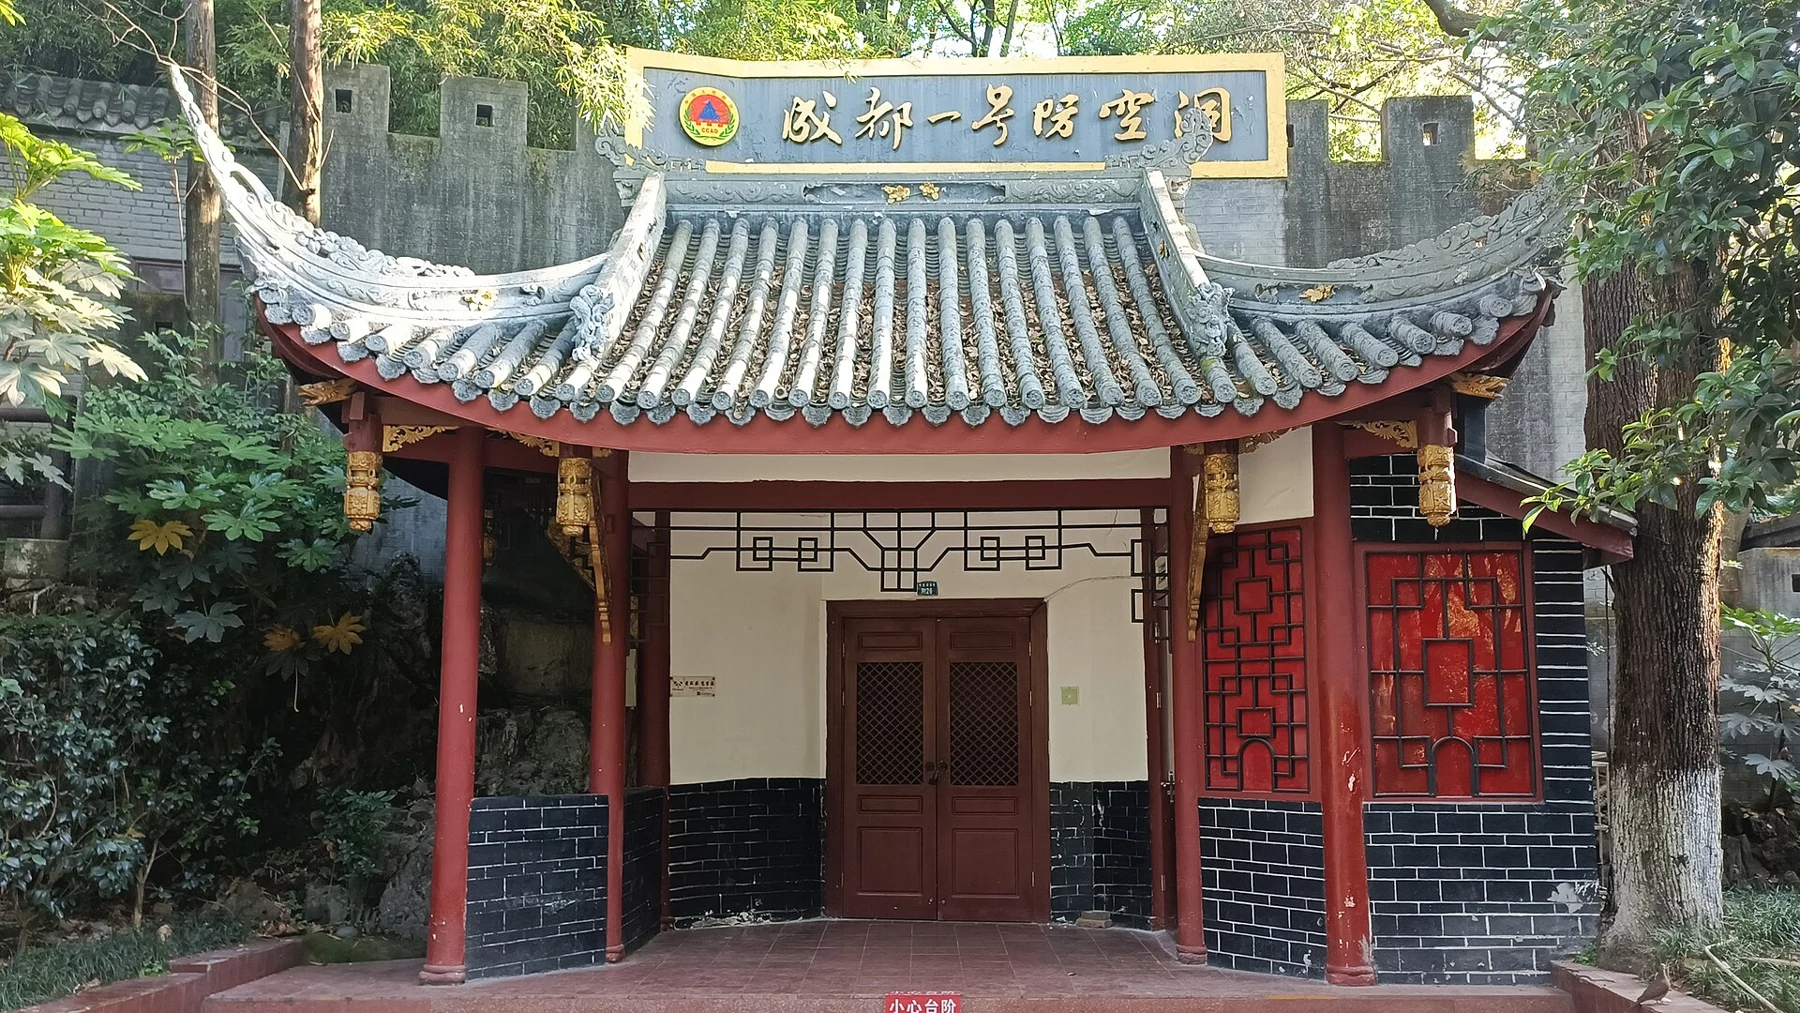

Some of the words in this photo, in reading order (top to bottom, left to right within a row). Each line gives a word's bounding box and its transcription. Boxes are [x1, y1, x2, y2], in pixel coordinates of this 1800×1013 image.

[782, 83, 1232, 150] 成都一号防空洞
[889, 998, 957, 1013] 小心台阶
